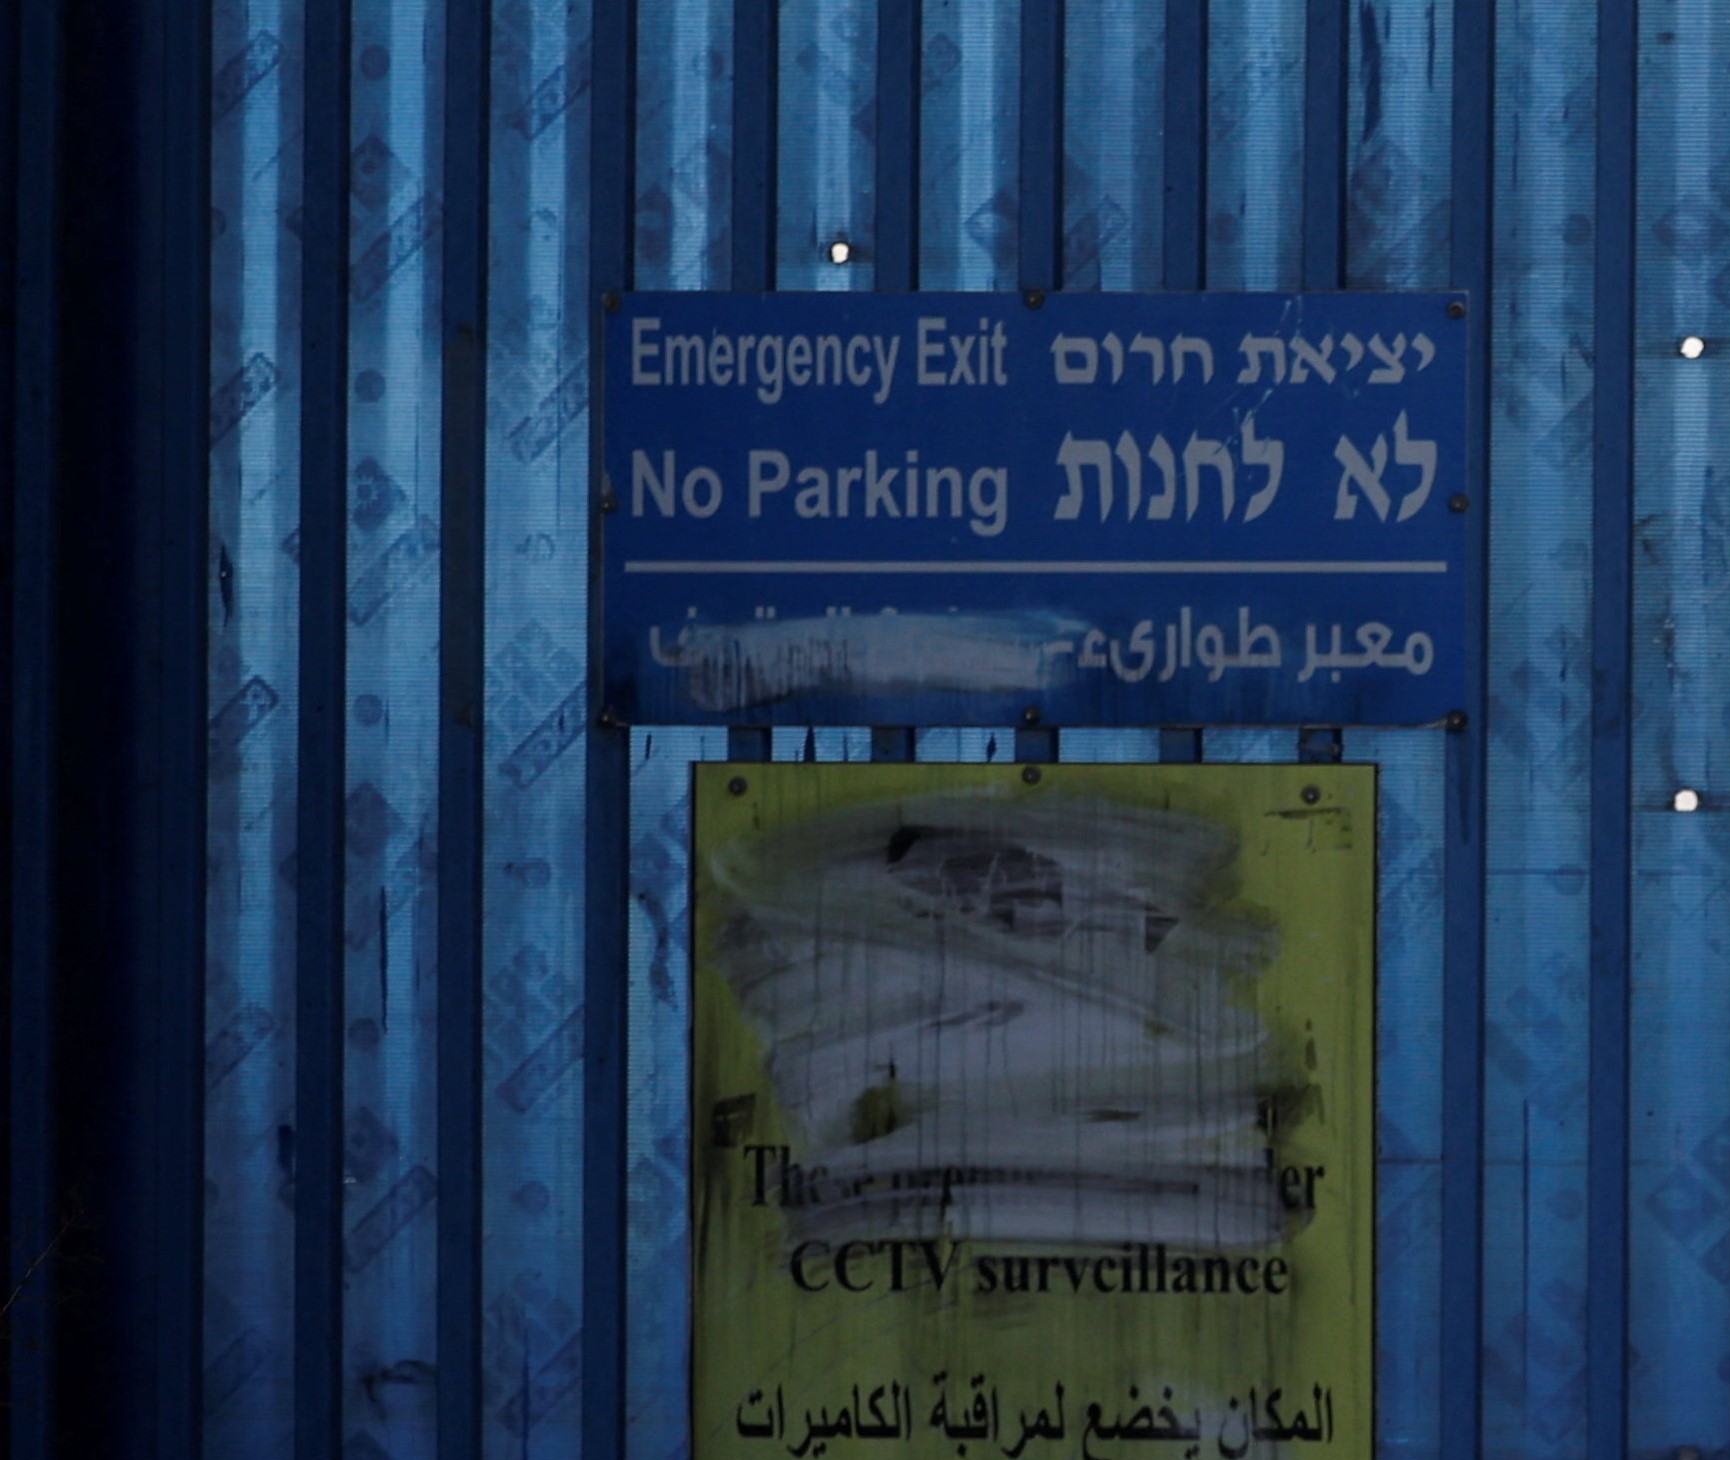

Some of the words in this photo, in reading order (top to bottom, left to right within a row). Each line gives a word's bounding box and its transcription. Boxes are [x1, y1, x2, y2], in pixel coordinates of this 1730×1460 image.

[631, 316, 901, 405] Emergency
[917, 316, 1008, 386] Exit
[1050, 331, 1214, 385] חרום
[1236, 331, 1436, 385] יציאת
[631, 449, 723, 519] No
[748, 449, 1008, 537] Parking
[1053, 408, 1284, 523] לחנות
[1333, 408, 1438, 523] לא
[1298, 621, 1434, 683] معبر
[791, 1240, 961, 1292] CCTV
[737, 1380, 911, 1458] الكاميرات
[931, 1371, 1064, 1458] لمراقبة
[1218, 1383, 1333, 1460] المكان
